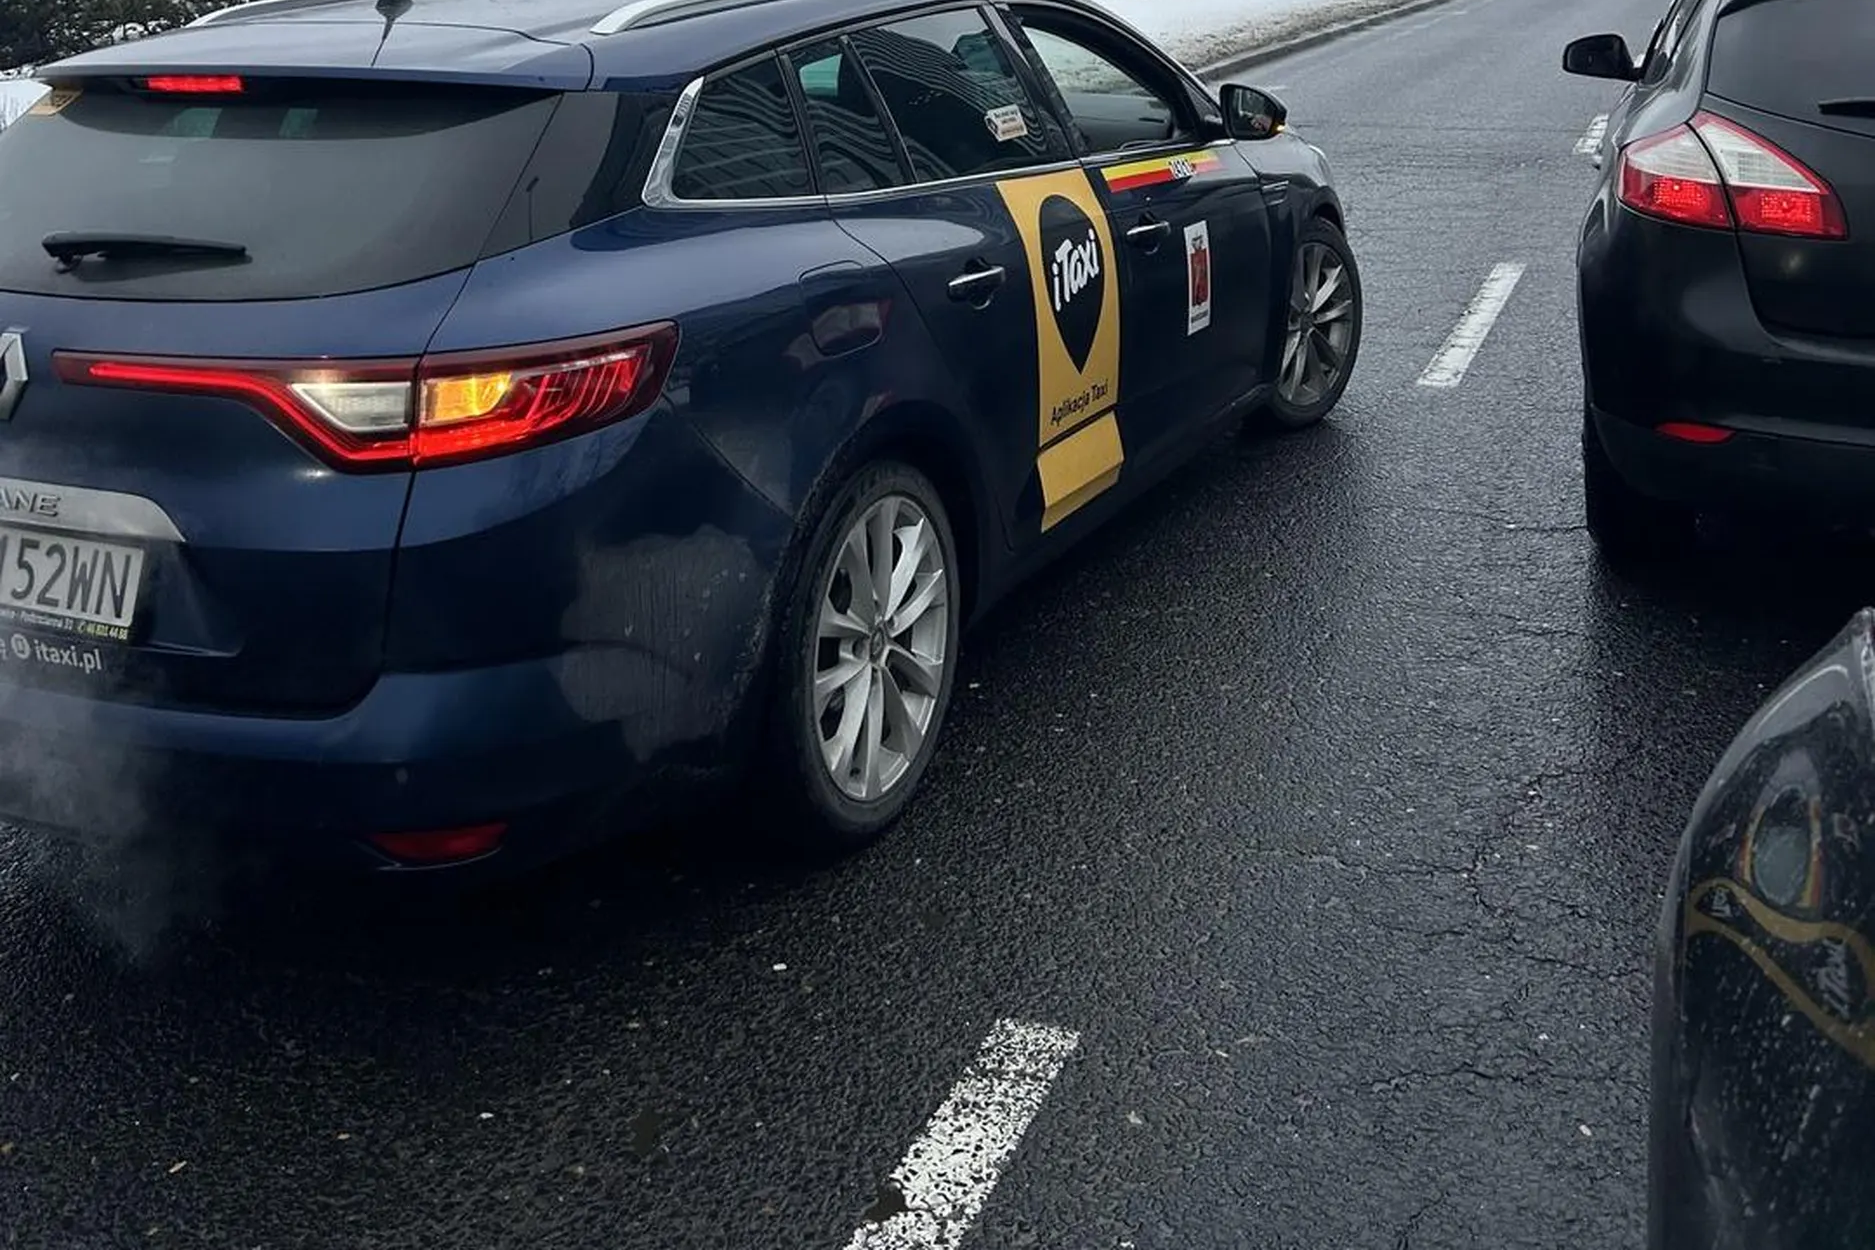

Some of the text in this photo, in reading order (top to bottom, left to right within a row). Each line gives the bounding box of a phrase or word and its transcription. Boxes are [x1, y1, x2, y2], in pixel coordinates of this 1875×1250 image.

[1052, 228, 1100, 312] iTaxi
[1091, 377, 1109, 403] Taxi
[34, 639, 102, 674] itaxi.pl
